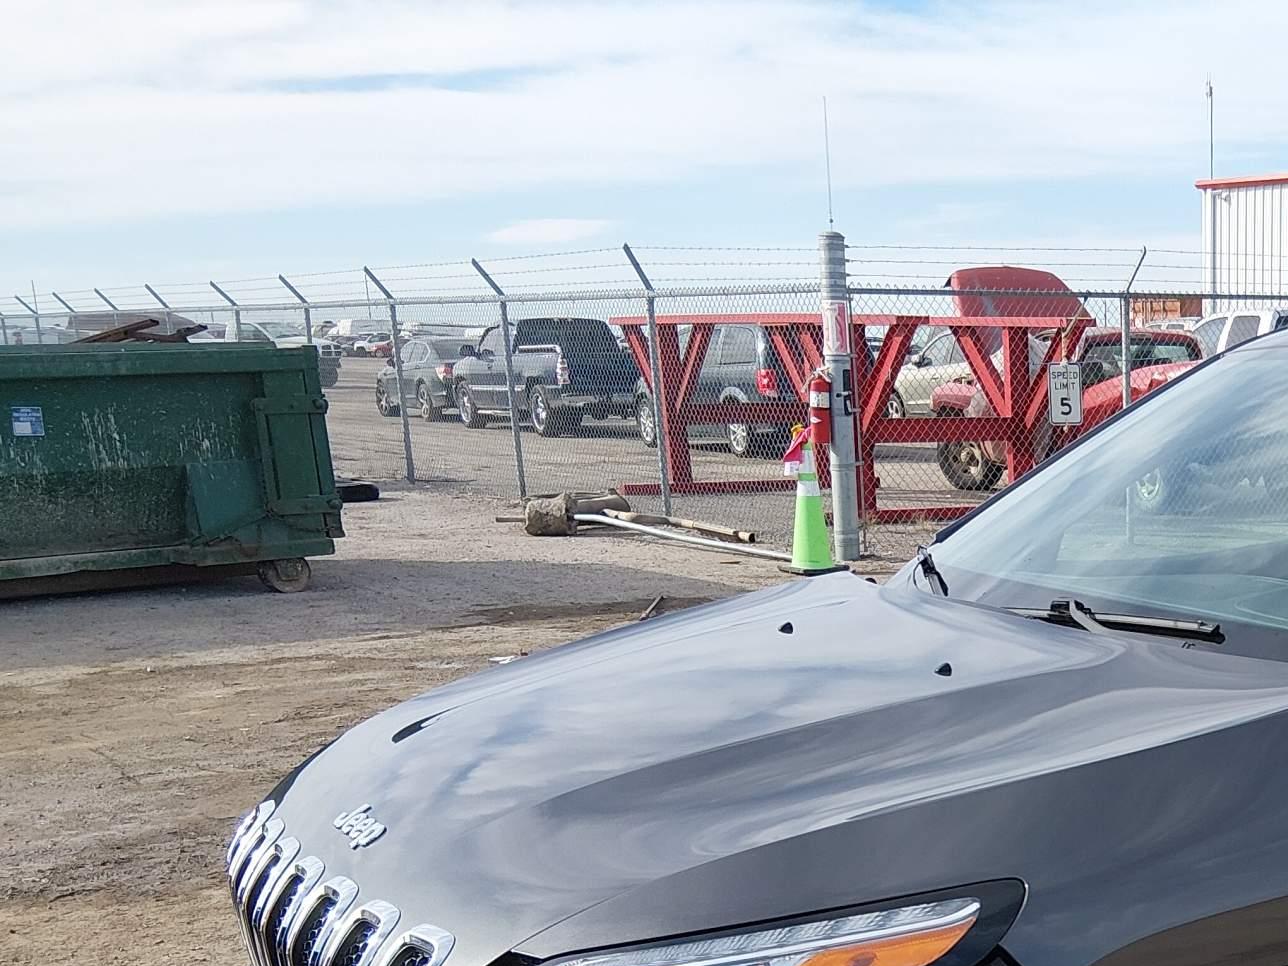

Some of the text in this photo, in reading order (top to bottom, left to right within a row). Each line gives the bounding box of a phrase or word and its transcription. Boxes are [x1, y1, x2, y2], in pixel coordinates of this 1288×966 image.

[1051, 371, 1078, 380] SPEED
[1054, 382, 1076, 391] LIMIT
[1060, 397, 1072, 416] 5
[333, 803, 387, 850] Jeep
